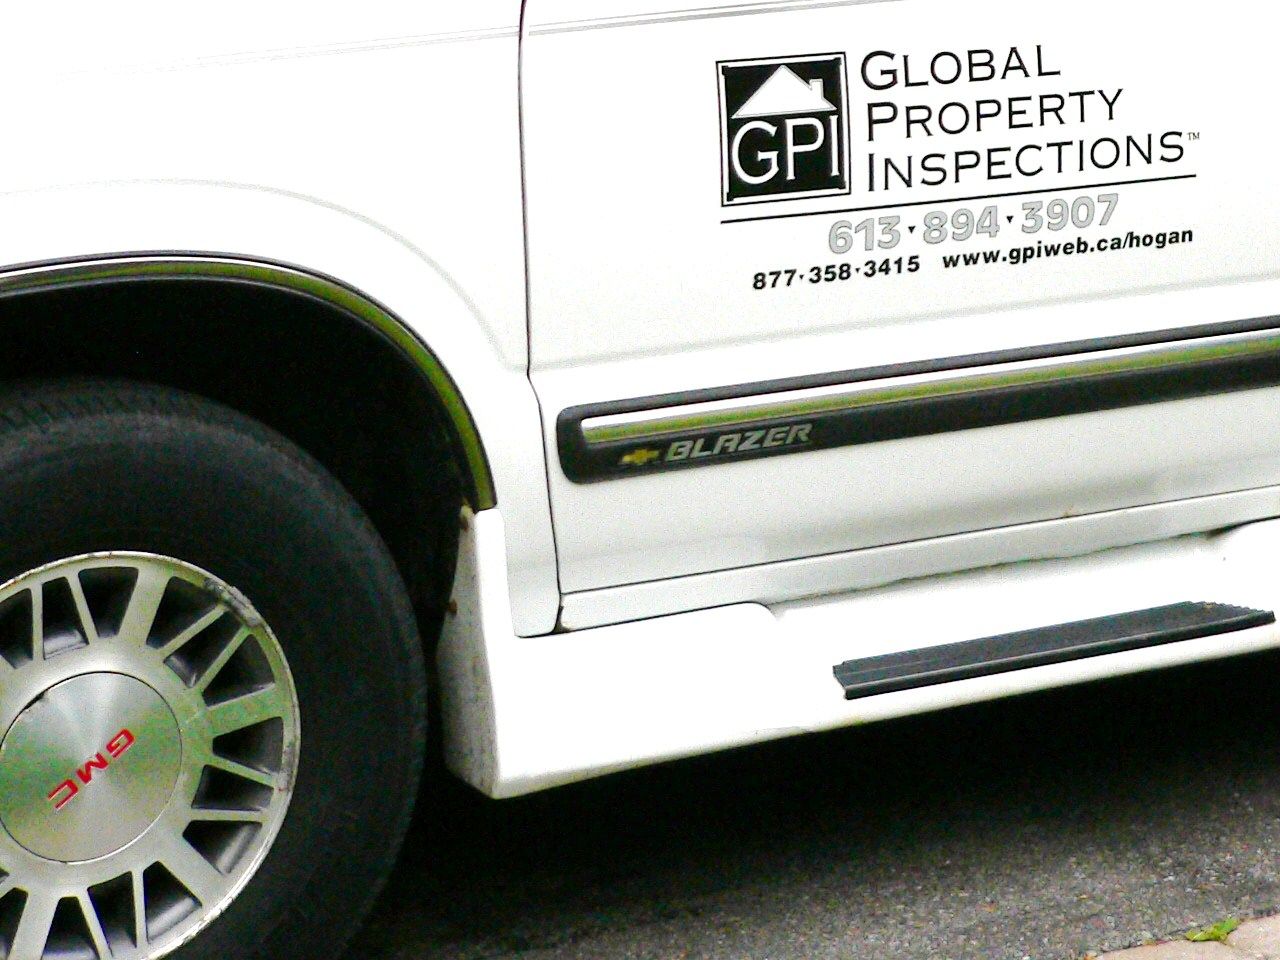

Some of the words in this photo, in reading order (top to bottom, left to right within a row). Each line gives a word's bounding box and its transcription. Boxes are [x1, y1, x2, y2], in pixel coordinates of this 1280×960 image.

[861, 44, 1061, 91] GLOBAL
[867, 88, 1124, 142] PROPERTY
[731, 115, 840, 186] GPI
[942, 228, 1194, 270] www.gpiweb.ca/hogan
[665, 423, 814, 462] BLAZER
[48, 728, 136, 810] GMC
